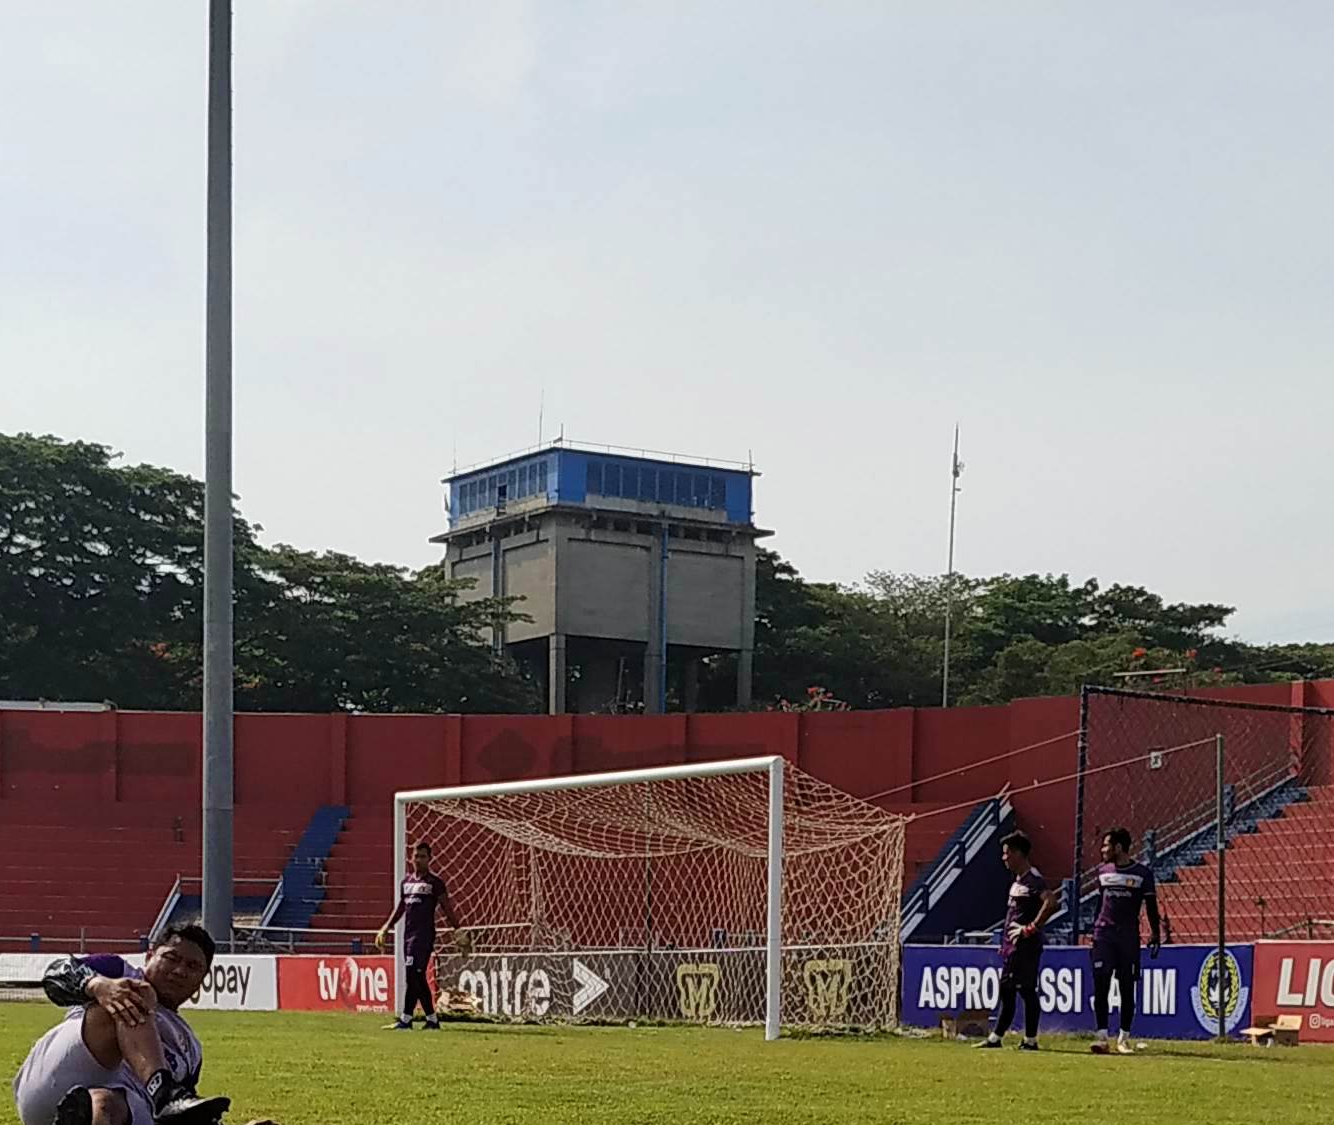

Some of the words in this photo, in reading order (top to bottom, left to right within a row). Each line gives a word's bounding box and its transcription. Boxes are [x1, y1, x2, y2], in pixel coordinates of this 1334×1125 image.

[317, 955, 388, 1005] tvOne
[918, 966, 1003, 1010] ASPRO
[1035, 967, 1082, 1013] SSI
